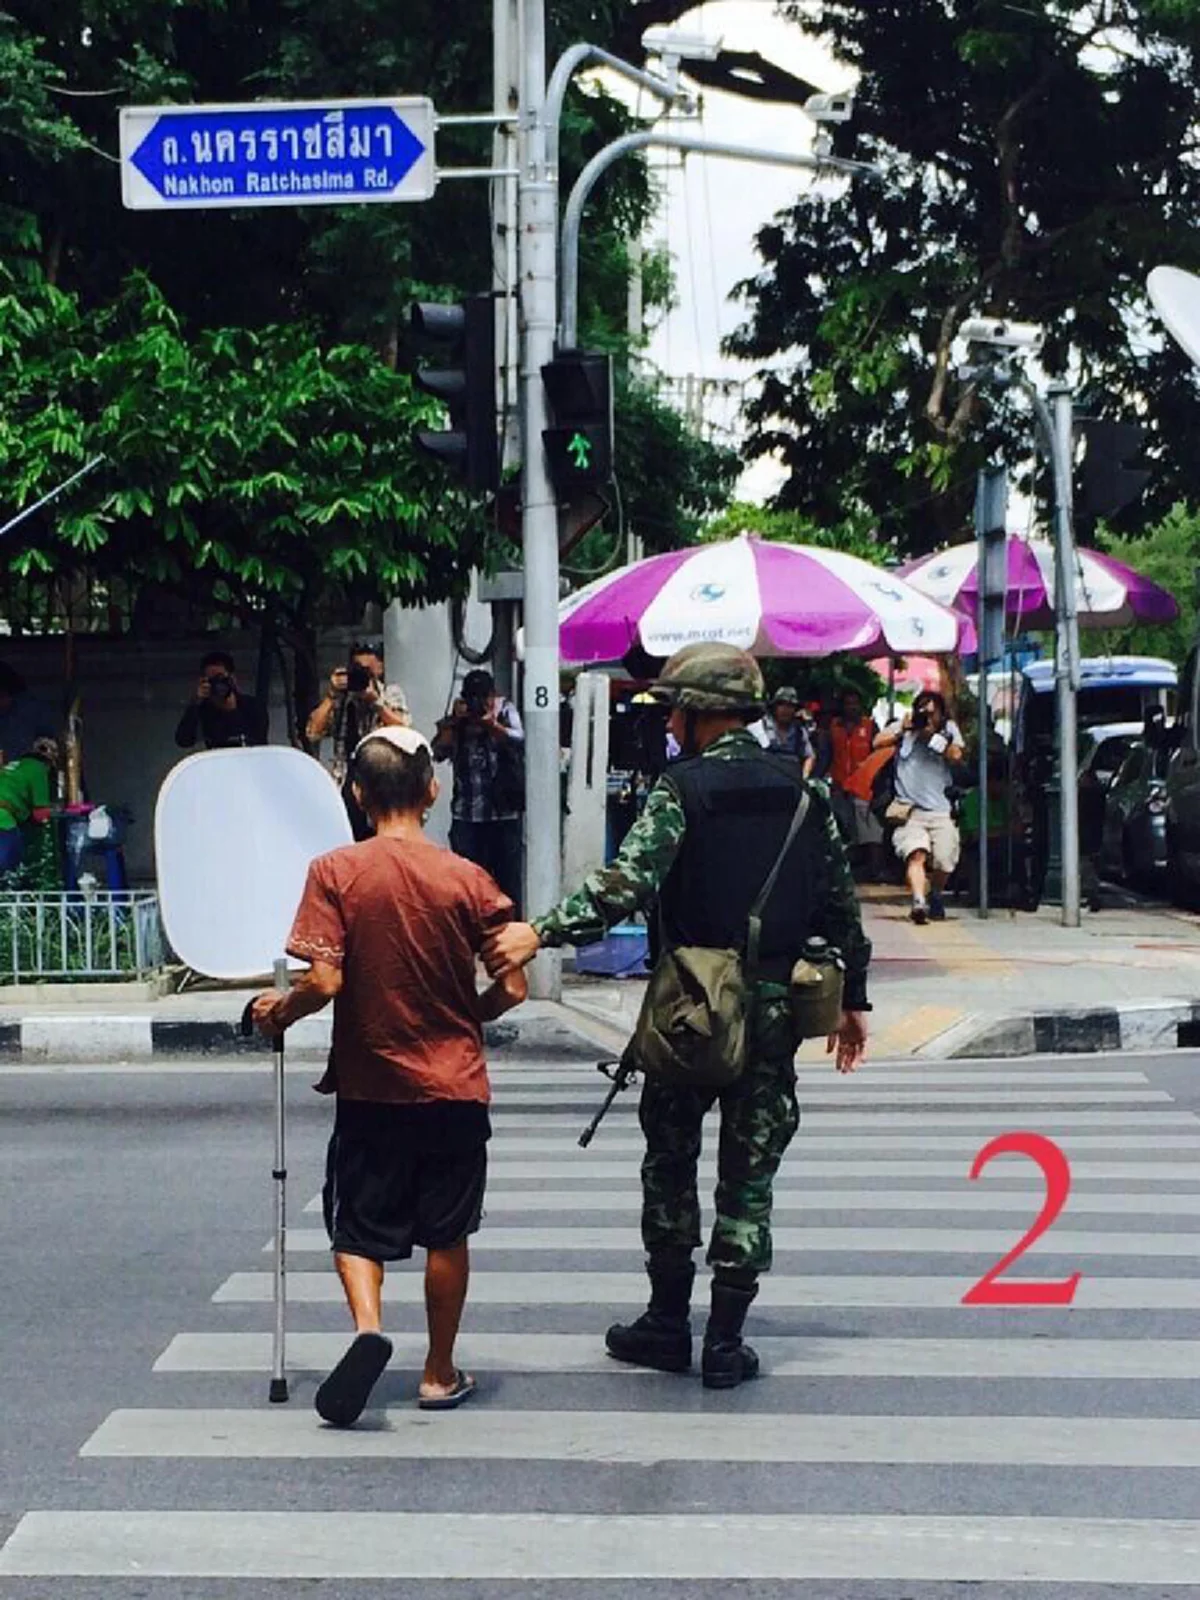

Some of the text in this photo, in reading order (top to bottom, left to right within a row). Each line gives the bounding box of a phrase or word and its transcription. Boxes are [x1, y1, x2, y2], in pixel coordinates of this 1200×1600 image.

[163, 110, 393, 166] ถ.นครราชสีมา
[163, 165, 394, 196] Nakhon Ratchasima Rd.
[535, 685, 549, 708] 8
